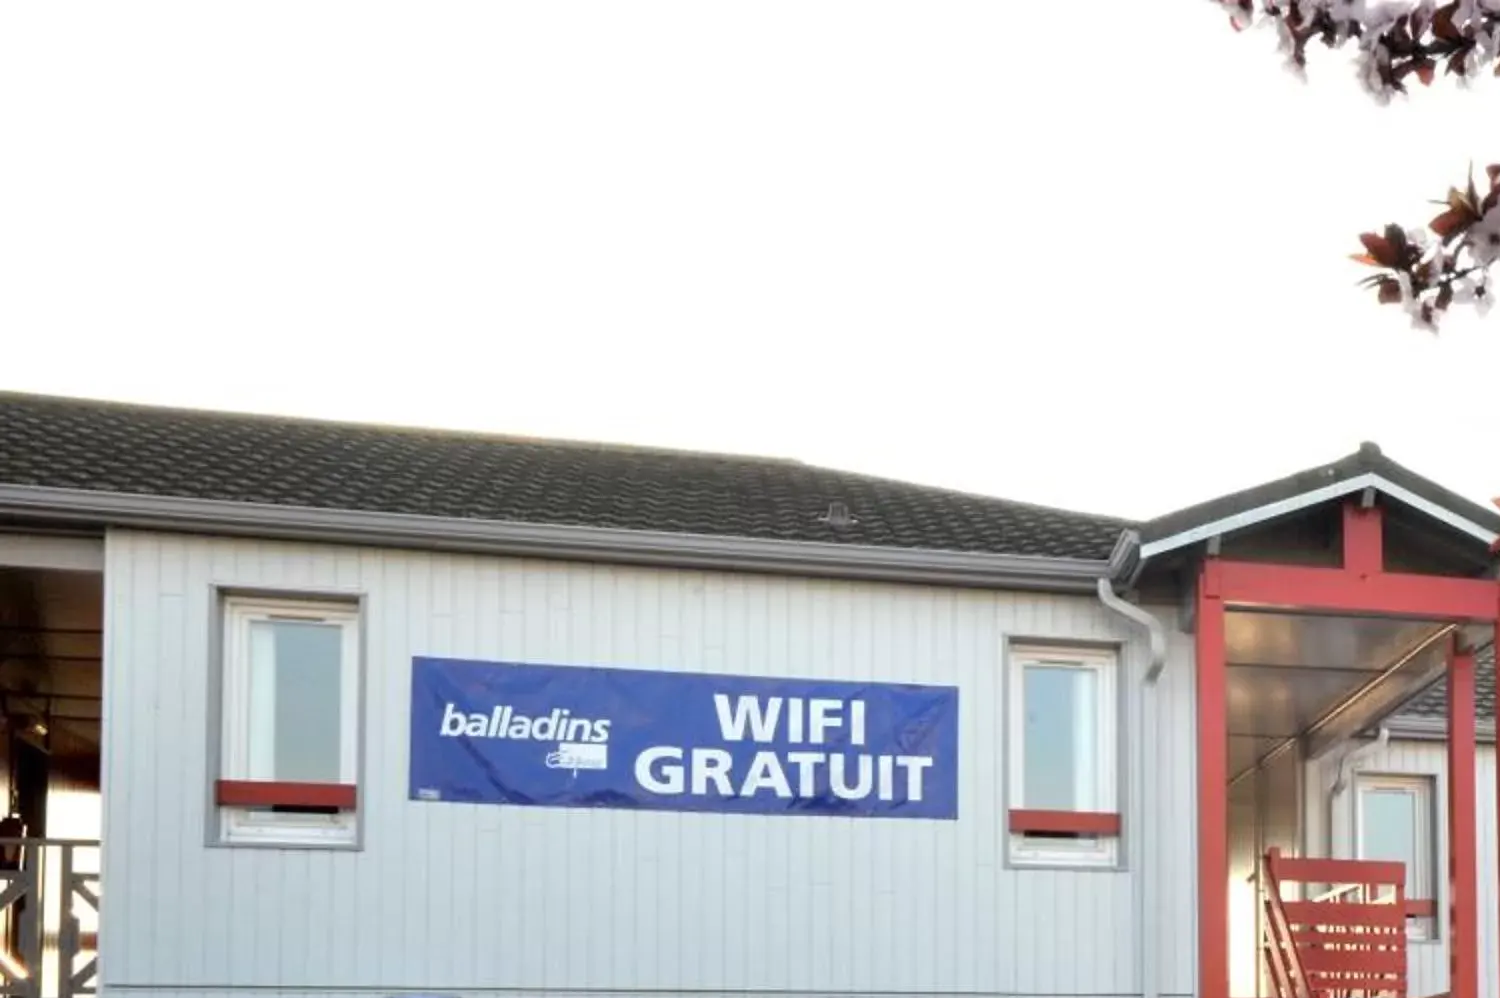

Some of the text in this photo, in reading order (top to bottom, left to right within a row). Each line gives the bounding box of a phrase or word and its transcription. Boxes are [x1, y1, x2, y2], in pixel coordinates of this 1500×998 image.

[440, 703, 612, 742] balladins
[714, 694, 866, 745] WIFI
[634, 746, 933, 801] GRATUIT
